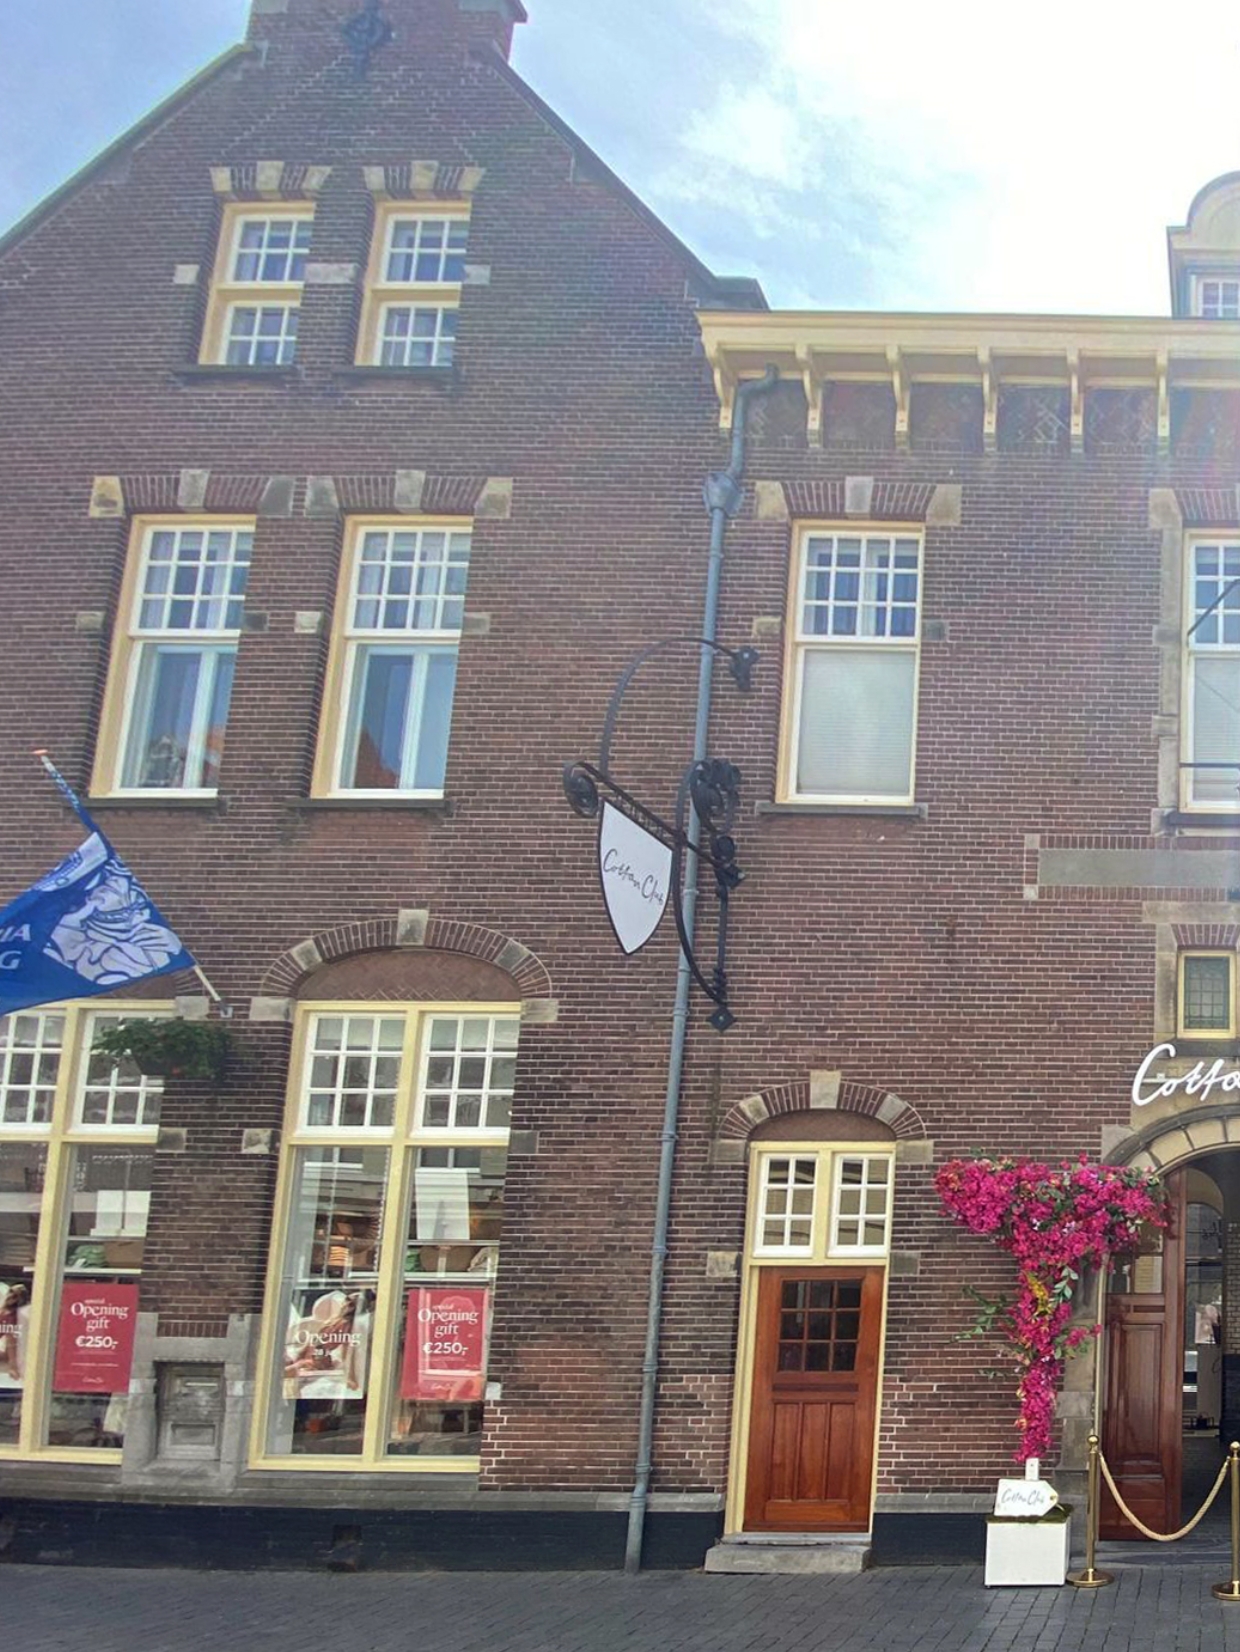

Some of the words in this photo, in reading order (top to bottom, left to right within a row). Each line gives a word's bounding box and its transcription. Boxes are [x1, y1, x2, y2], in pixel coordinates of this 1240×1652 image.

[603, 848, 640, 890] Cotton
[641, 874, 664, 905] Club
[70, 1302, 129, 1320] Opening
[418, 1308, 480, 1326] Opening
[86, 1315, 111, 1333] gift
[434, 1322, 460, 1339] gift
[75, 1335, 119, 1350] €250,-
[295, 1329, 362, 1348] Opening
[422, 1342, 469, 1356] €250,-
